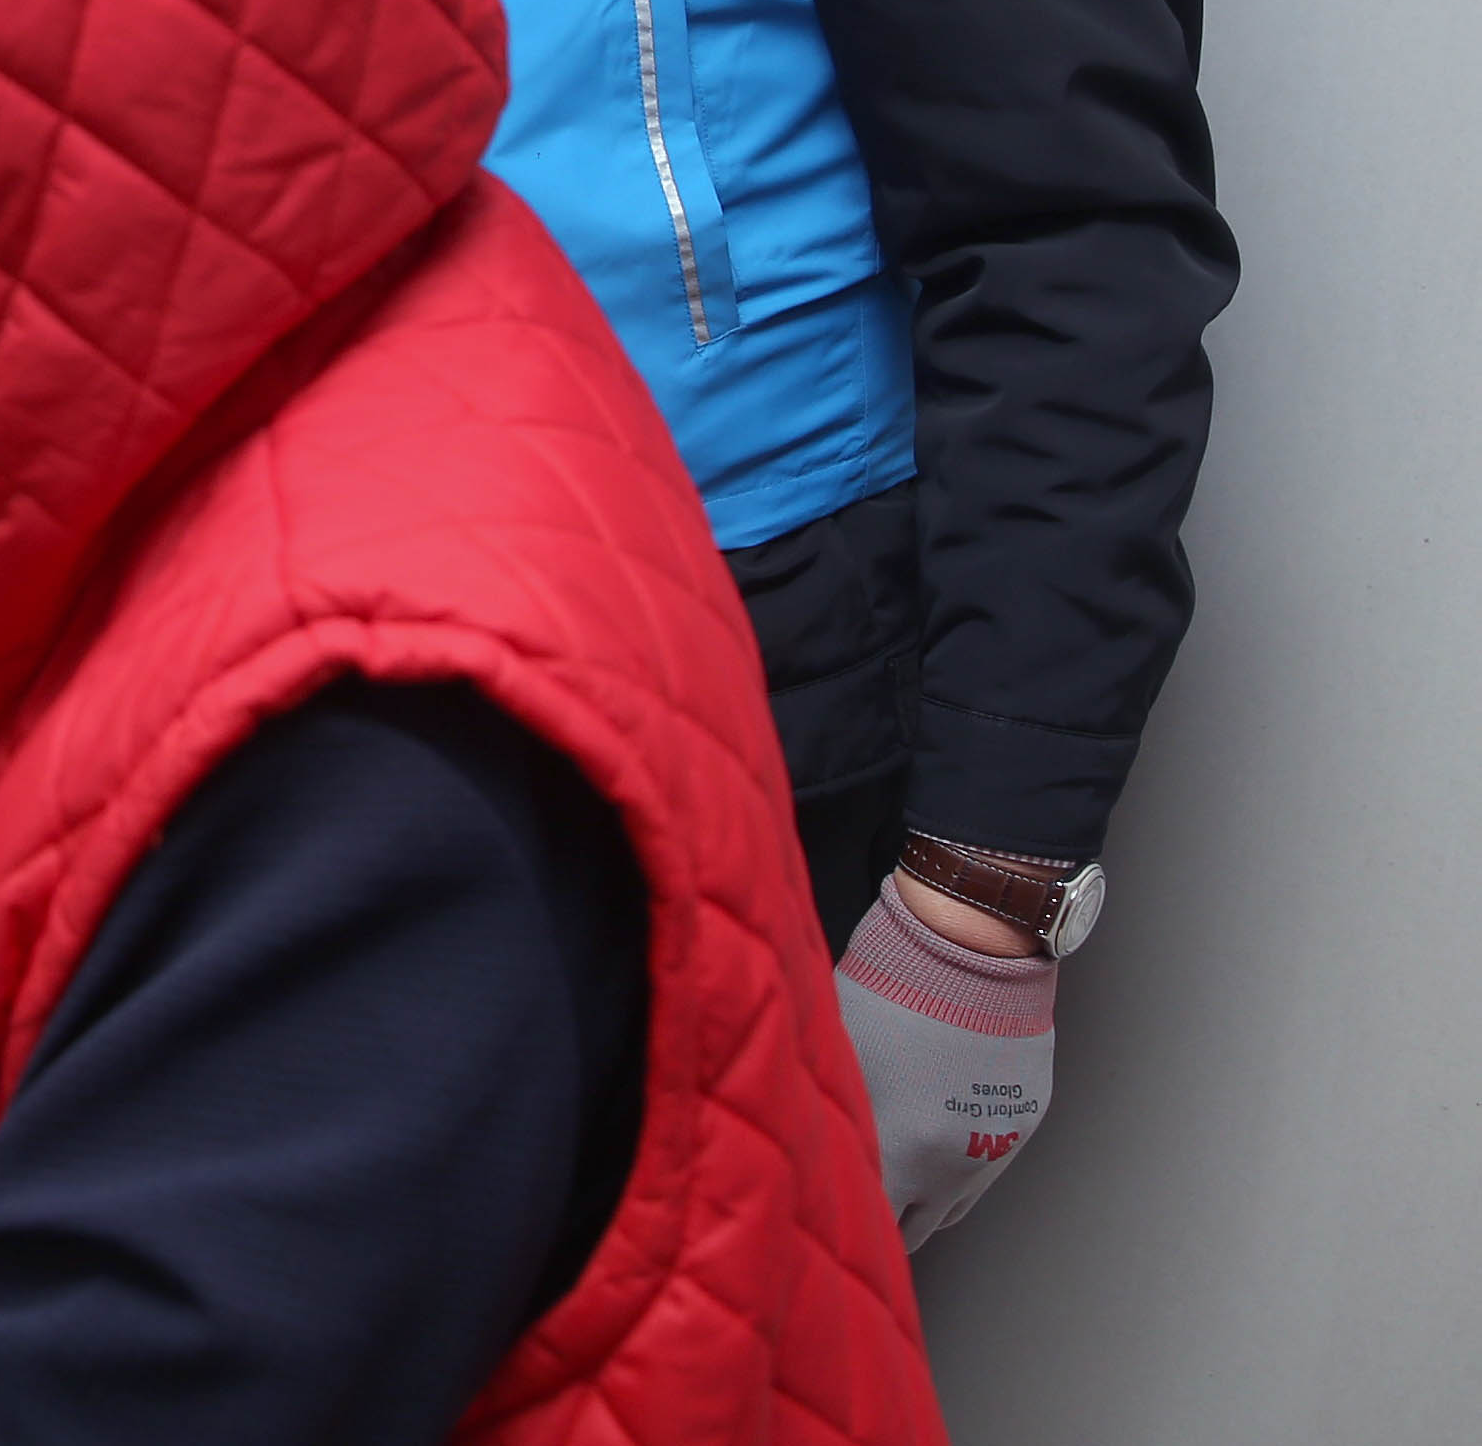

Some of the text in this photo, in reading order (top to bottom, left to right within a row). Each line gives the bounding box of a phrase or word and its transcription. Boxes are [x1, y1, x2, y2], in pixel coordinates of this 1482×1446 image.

[972, 1083, 1023, 1099] Gloves
[945, 1096, 1038, 1118] Comfort Grip
[966, 1131, 1020, 1162] 3M
